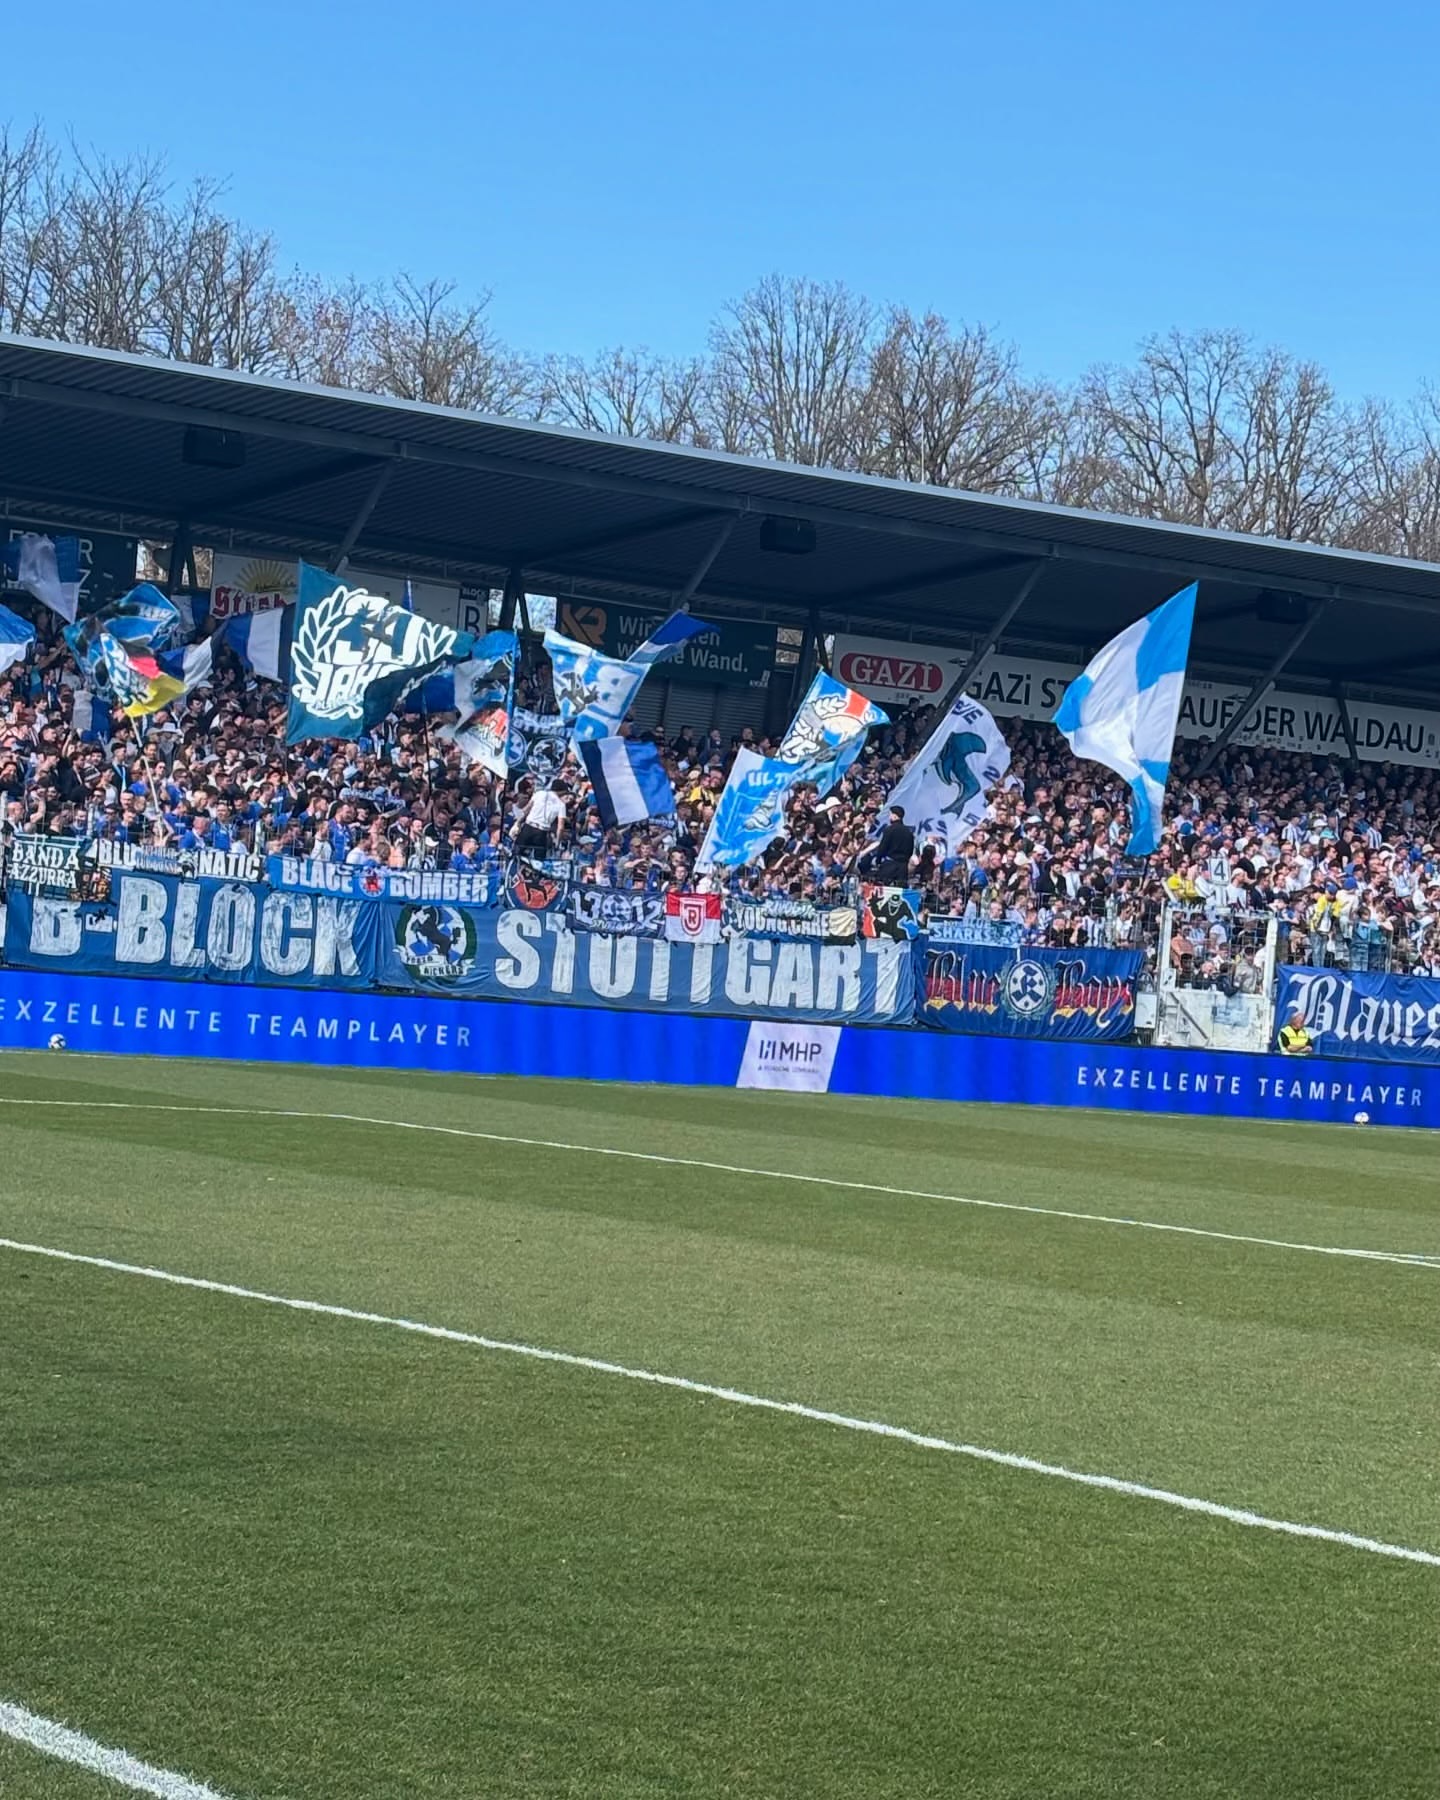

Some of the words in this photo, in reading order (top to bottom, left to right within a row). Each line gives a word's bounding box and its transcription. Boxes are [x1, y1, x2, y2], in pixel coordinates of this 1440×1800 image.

[690, 647, 748, 673] Wand.
[1177, 695, 1236, 729] AUF
[1303, 709, 1425, 754] WALDAU
[12, 841, 81, 871] BANDA
[98, 838, 146, 868] BLU
[9, 862, 78, 889] AZZURRA
[1213, 861, 1226, 881] 4
[933, 924, 992, 943] SHARKS
[495, 908, 908, 1015] STUTTGART
[248, 1013, 471, 1047] TEAMPLAYER
[1078, 1066, 1241, 1096] EXZELLENTE
[1259, 1077, 1423, 1108] TEAMPLAYER
